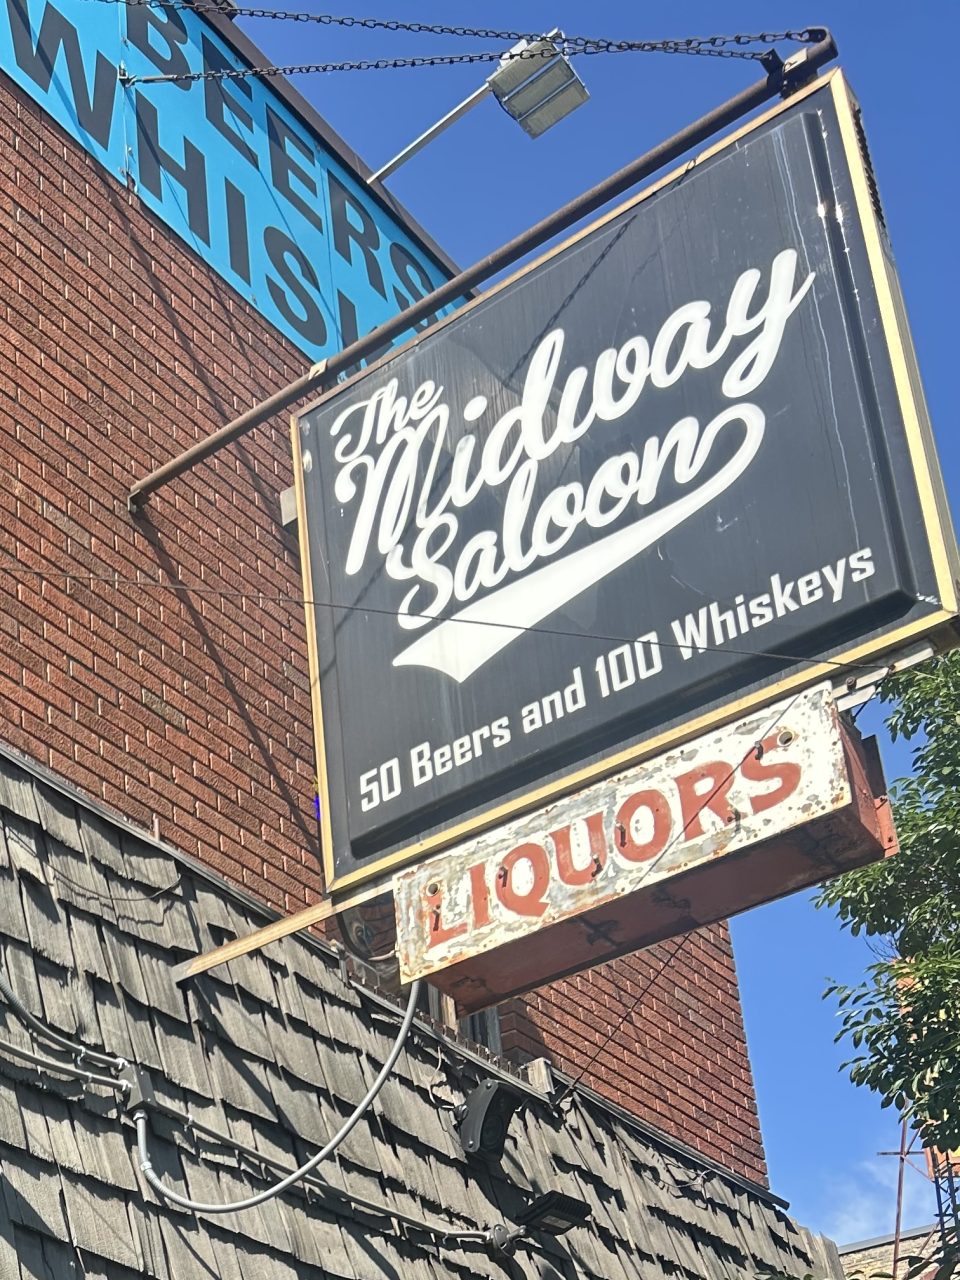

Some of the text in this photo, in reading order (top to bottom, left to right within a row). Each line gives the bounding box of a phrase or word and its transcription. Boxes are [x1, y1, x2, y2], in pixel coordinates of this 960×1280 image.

[127, 0, 437, 334] BEERS
[335, 378, 443, 463] The
[340, 249, 815, 579] Midway
[396, 402, 766, 633] Saloon
[359, 546, 876, 813] 50 Beers and 100 Whiskeys
[424, 734, 803, 950] LIQUORS
